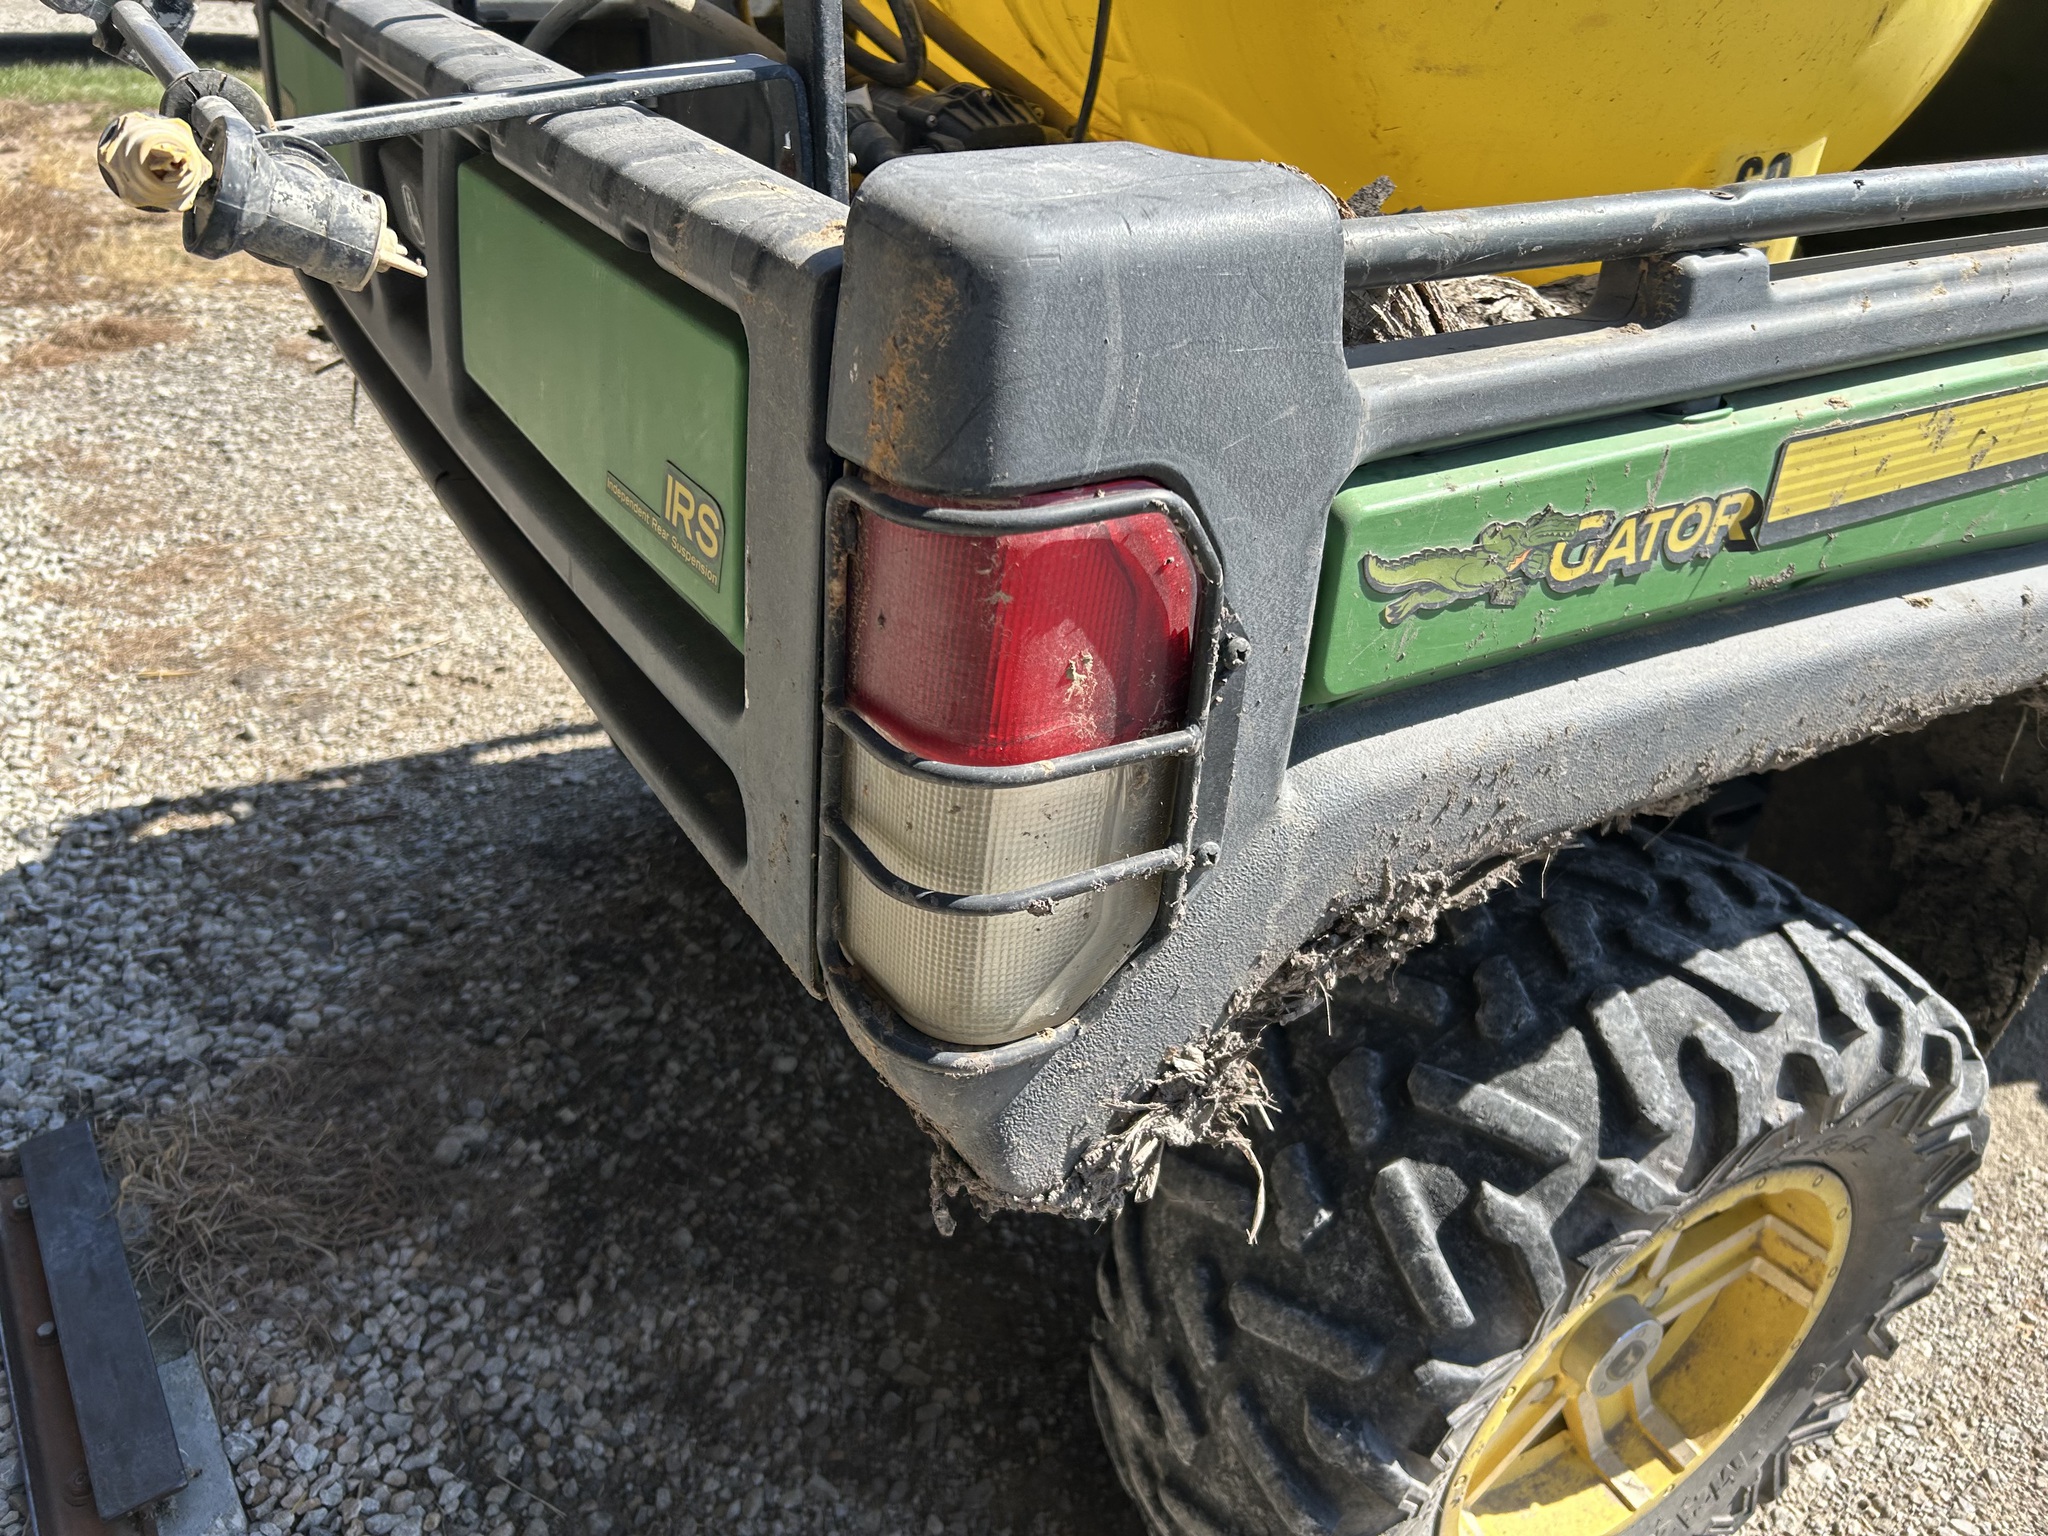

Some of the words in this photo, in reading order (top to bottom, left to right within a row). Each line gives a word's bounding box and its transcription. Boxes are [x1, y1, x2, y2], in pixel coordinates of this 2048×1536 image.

[606, 477, 651, 524] Independent
[651, 517, 670, 539] Rear
[671, 535, 718, 586] Suspension
[664, 473, 720, 559] IRS
[1546, 490, 1756, 584] GATOR
